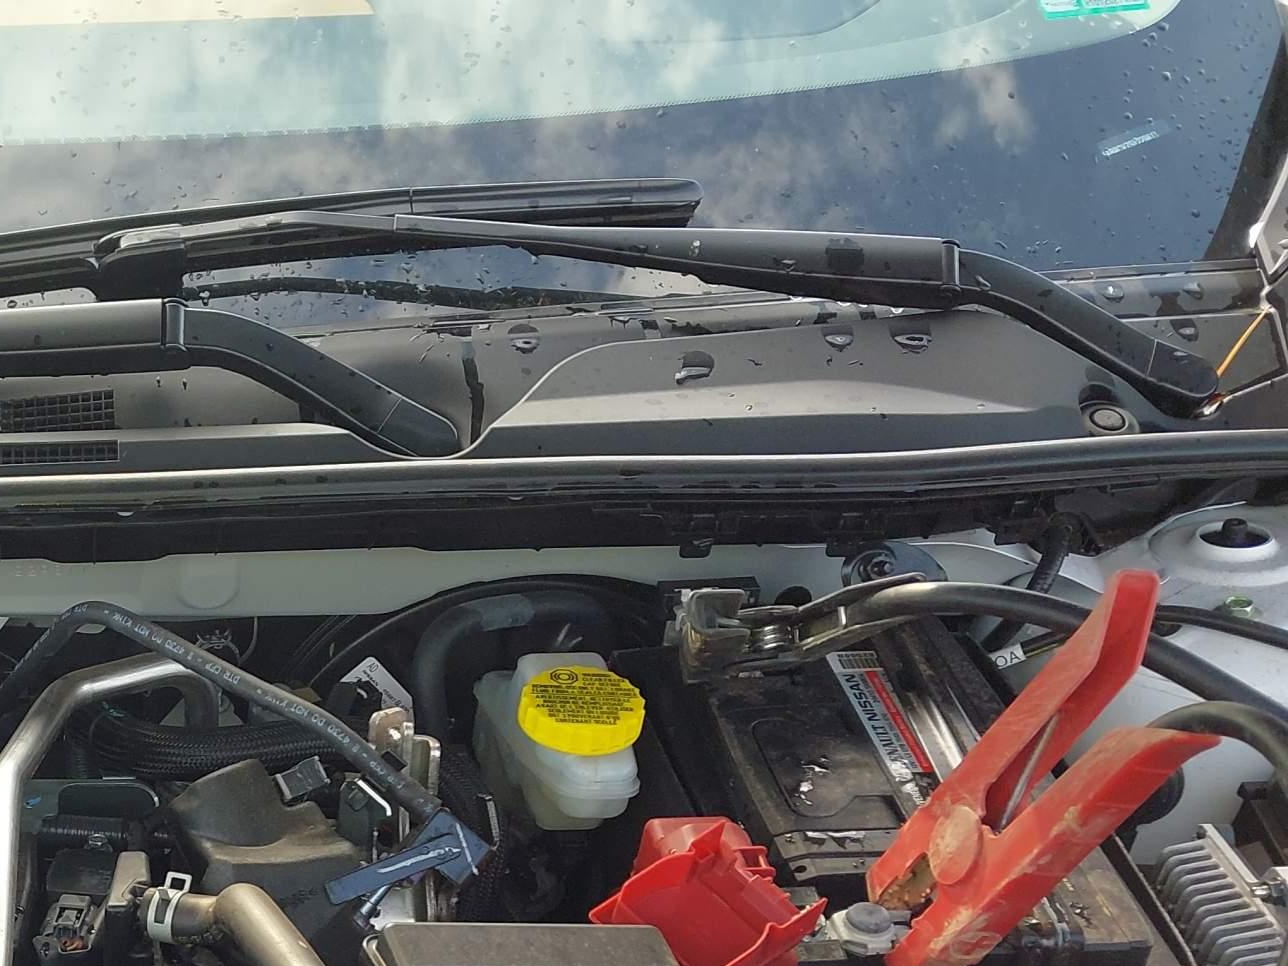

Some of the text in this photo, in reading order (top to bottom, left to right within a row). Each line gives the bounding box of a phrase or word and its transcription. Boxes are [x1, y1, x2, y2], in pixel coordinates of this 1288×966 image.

[134, 623, 151, 637] NOT
[843, 673, 881, 722] NISSAN
[311, 714, 325, 726] DO
[327, 725, 351, 744] 4730
